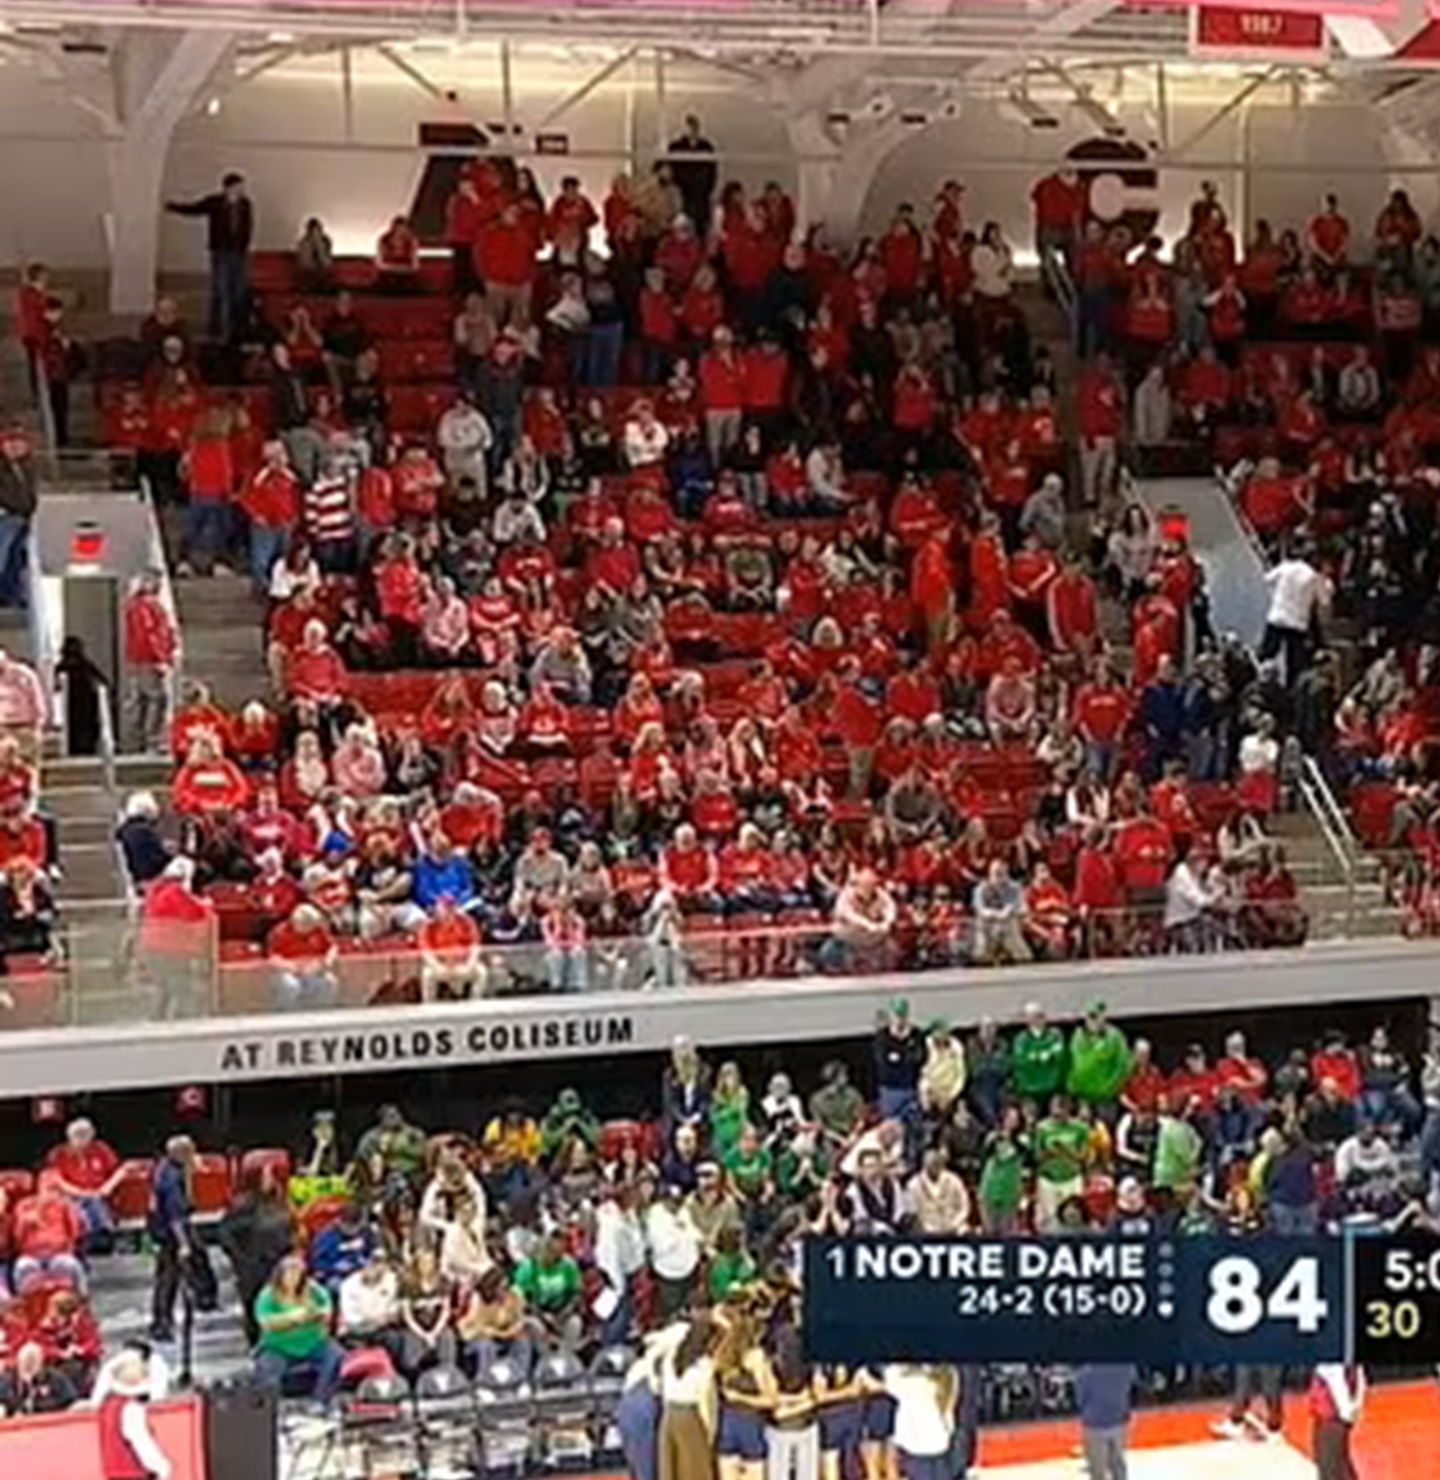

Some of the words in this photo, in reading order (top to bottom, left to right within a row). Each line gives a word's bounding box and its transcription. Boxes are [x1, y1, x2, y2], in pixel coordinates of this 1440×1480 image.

[220, 1043, 263, 1070] AT
[276, 1029, 453, 1066] REYNOLDS
[467, 1017, 633, 1051] COLISEUM
